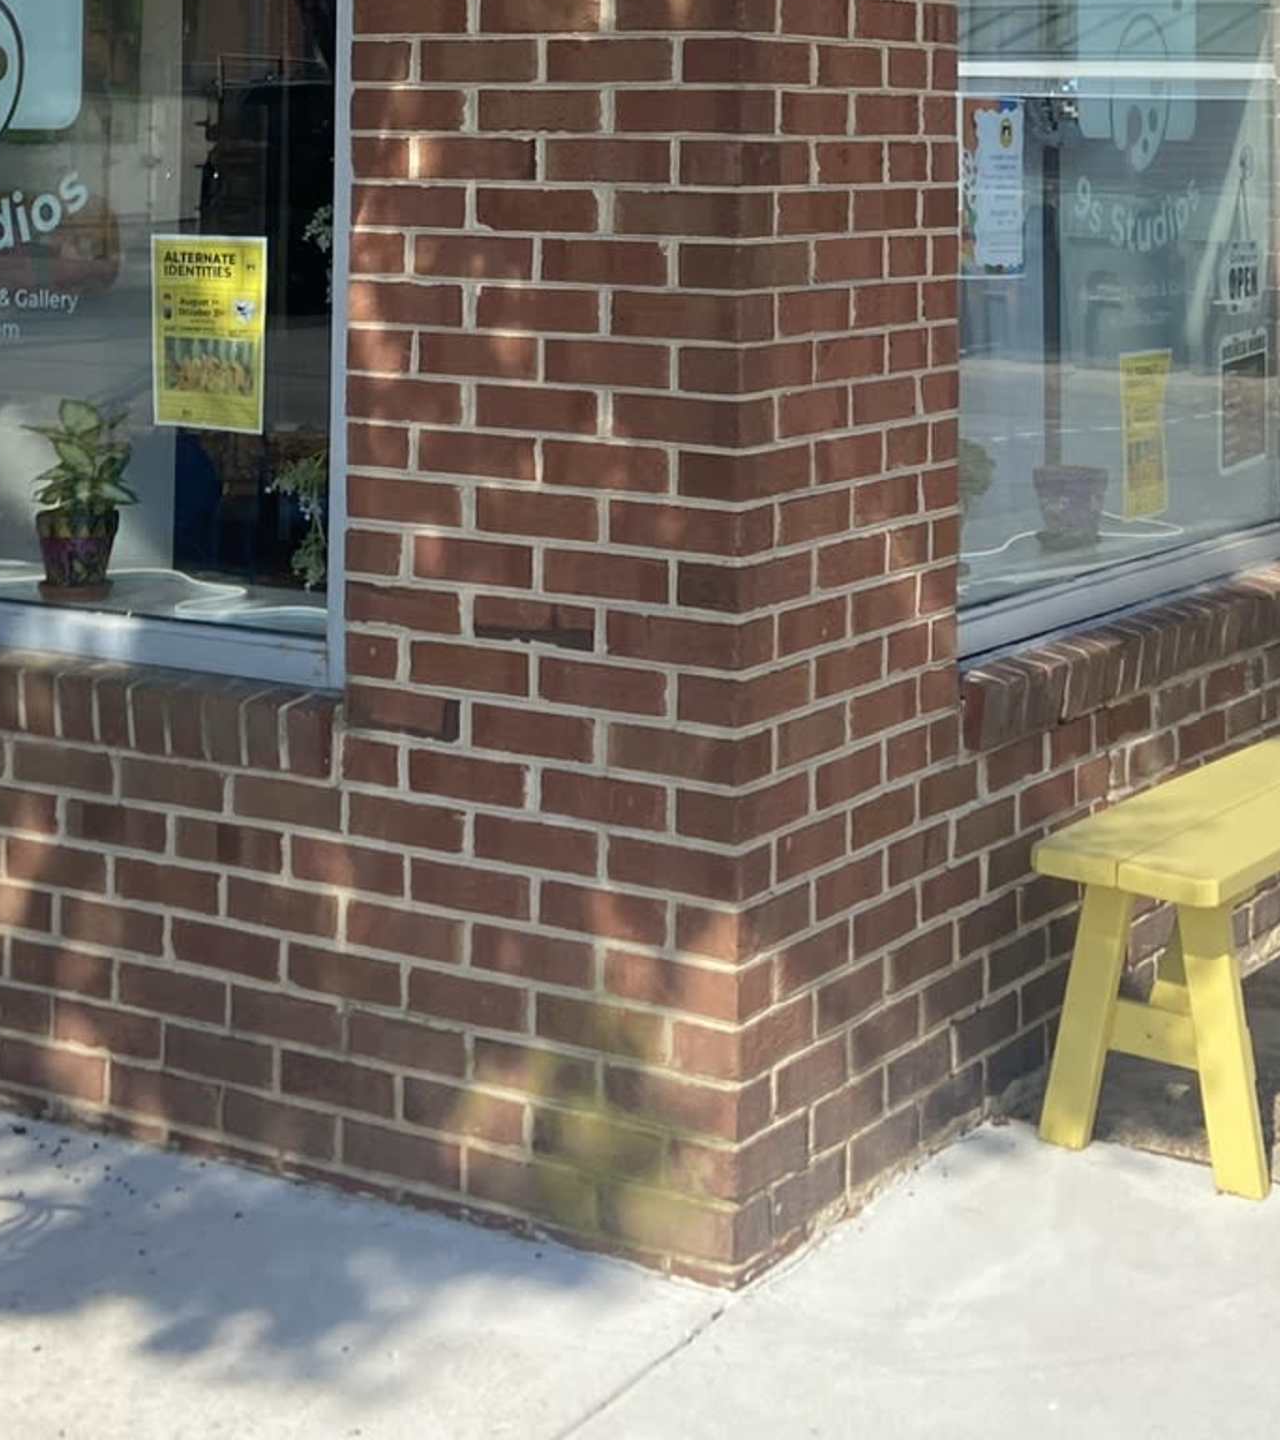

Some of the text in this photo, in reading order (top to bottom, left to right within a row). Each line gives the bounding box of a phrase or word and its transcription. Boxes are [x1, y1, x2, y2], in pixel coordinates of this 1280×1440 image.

[1074, 176, 1104, 233] 9s
[1110, 179, 1200, 253] Studios
[163, 251, 236, 265] ALTERNATE
[163, 265, 232, 278] IDENTITIES
[1228, 265, 1258, 300] OPEN
[15, 288, 79, 314] Gallery
